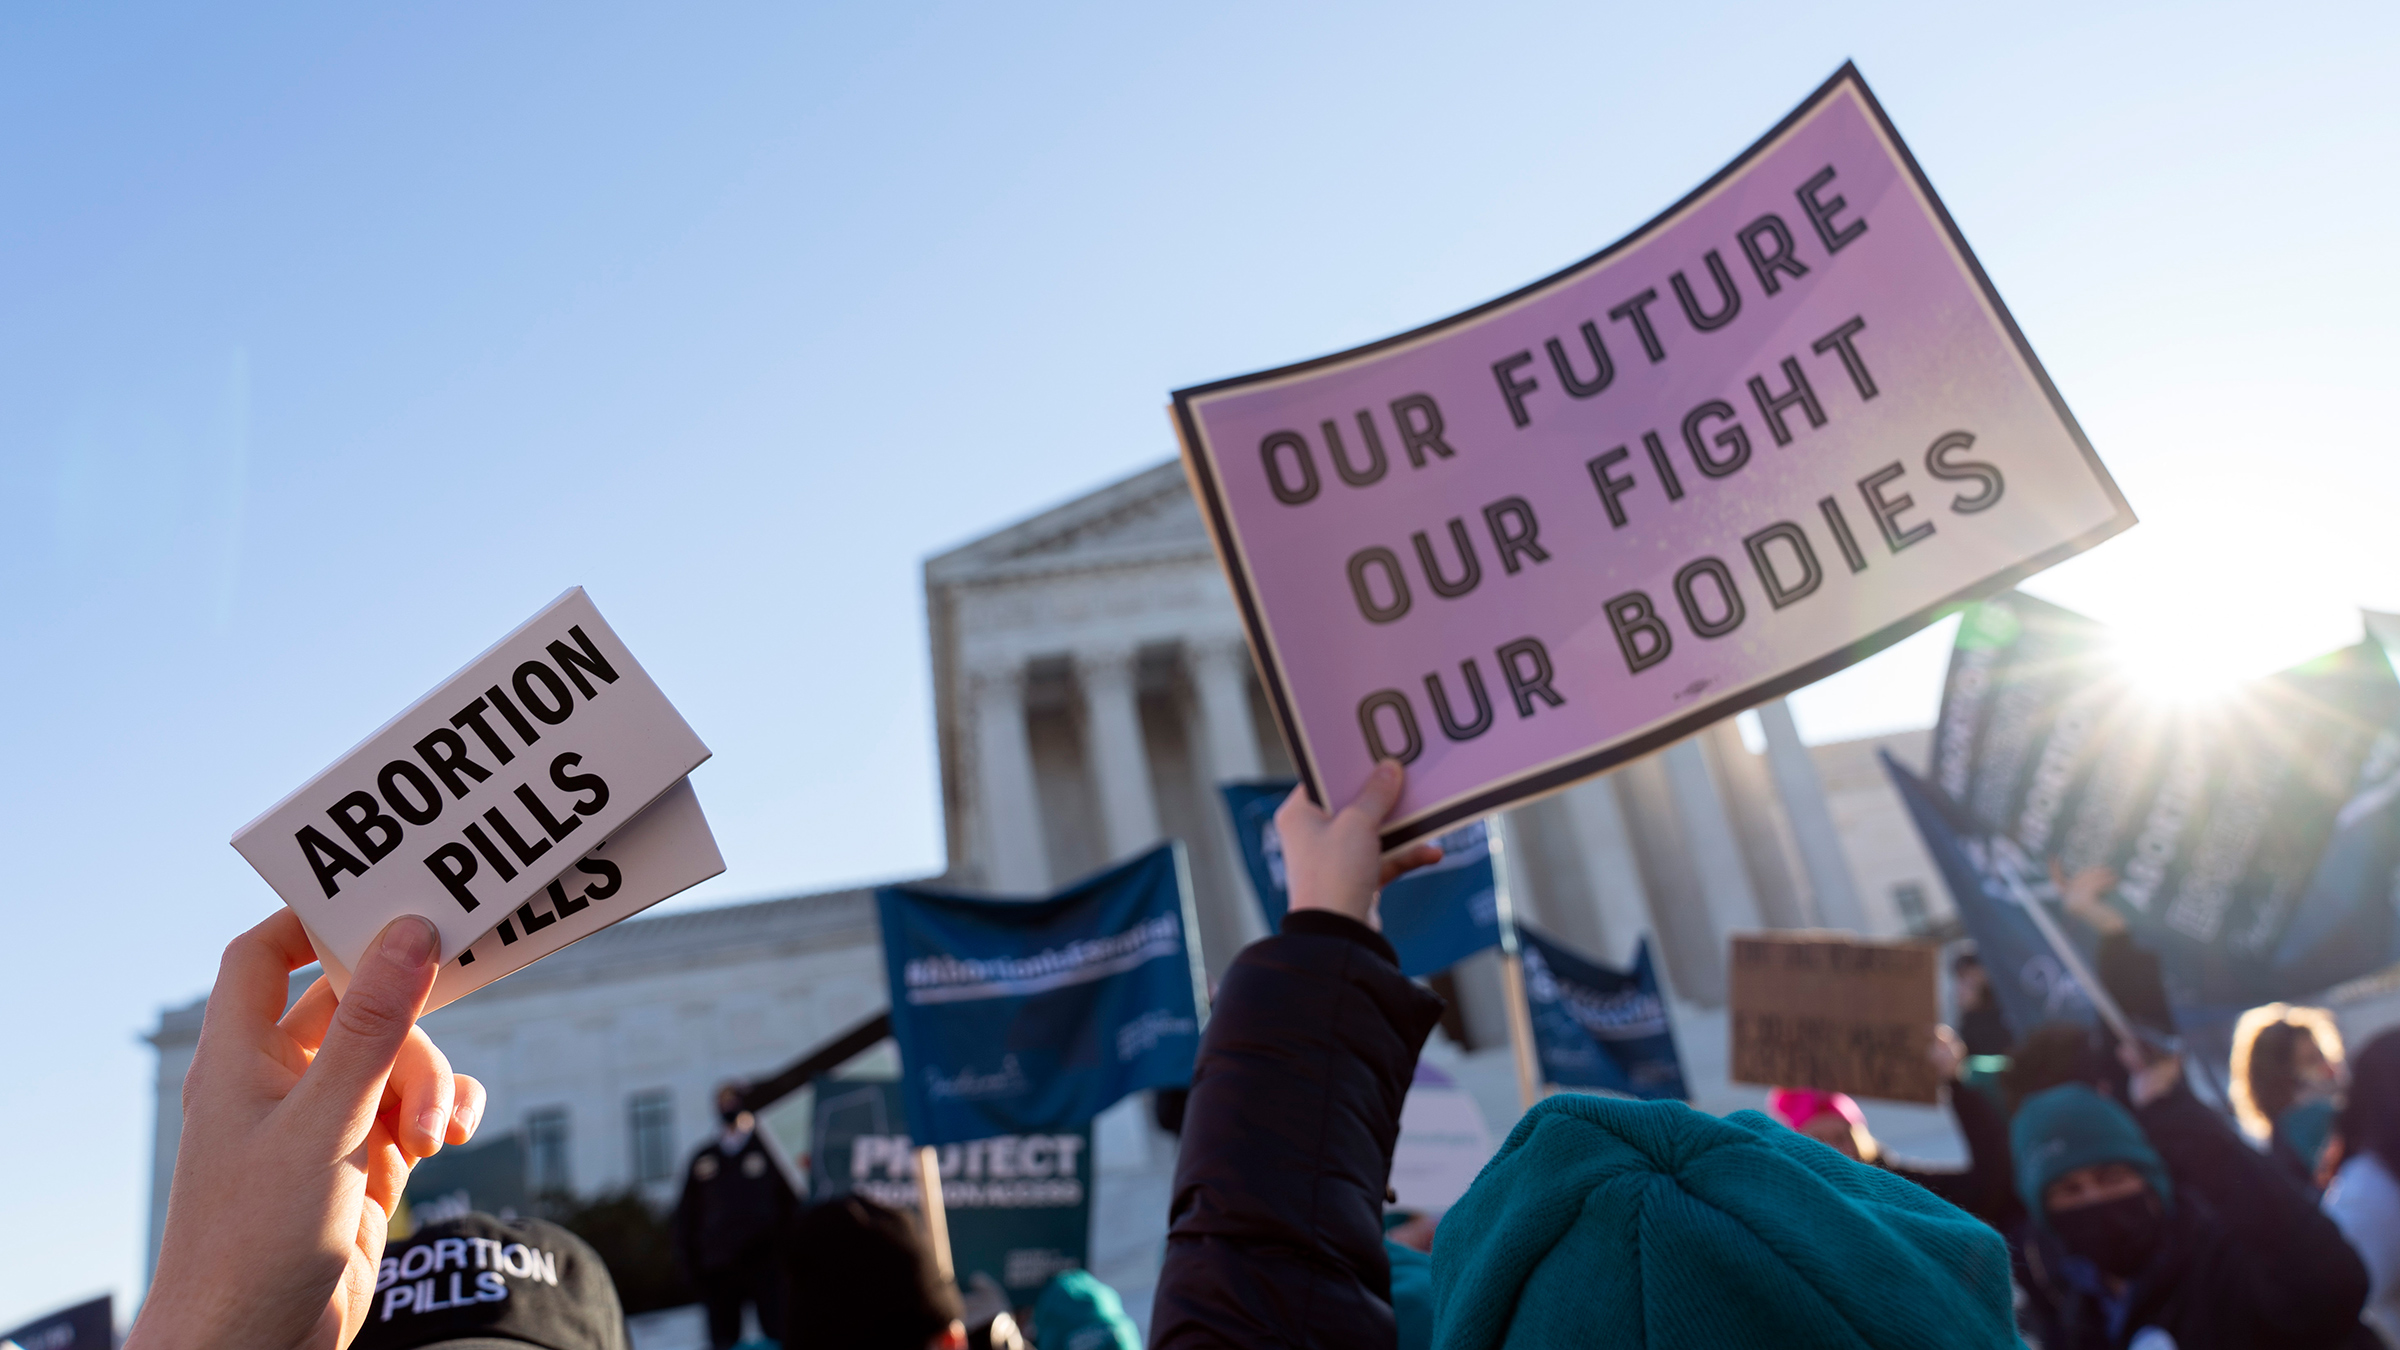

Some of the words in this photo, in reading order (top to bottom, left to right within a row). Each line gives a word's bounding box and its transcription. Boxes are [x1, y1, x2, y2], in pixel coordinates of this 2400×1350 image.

[1258, 390, 1456, 507] OUR
[1490, 163, 1869, 430] FUTURE
[1345, 496, 1551, 625] OUR
[1586, 315, 1881, 528] FIGHT
[1356, 636, 1566, 768] OUR
[1604, 430, 2006, 674] BODIES
[294, 624, 620, 900] ABORTION
[422, 751, 610, 914] PILLS
[456, 839, 623, 967] ILLS
[376, 1237, 558, 1292] BORTION
[380, 1271, 508, 1322] PILLS
